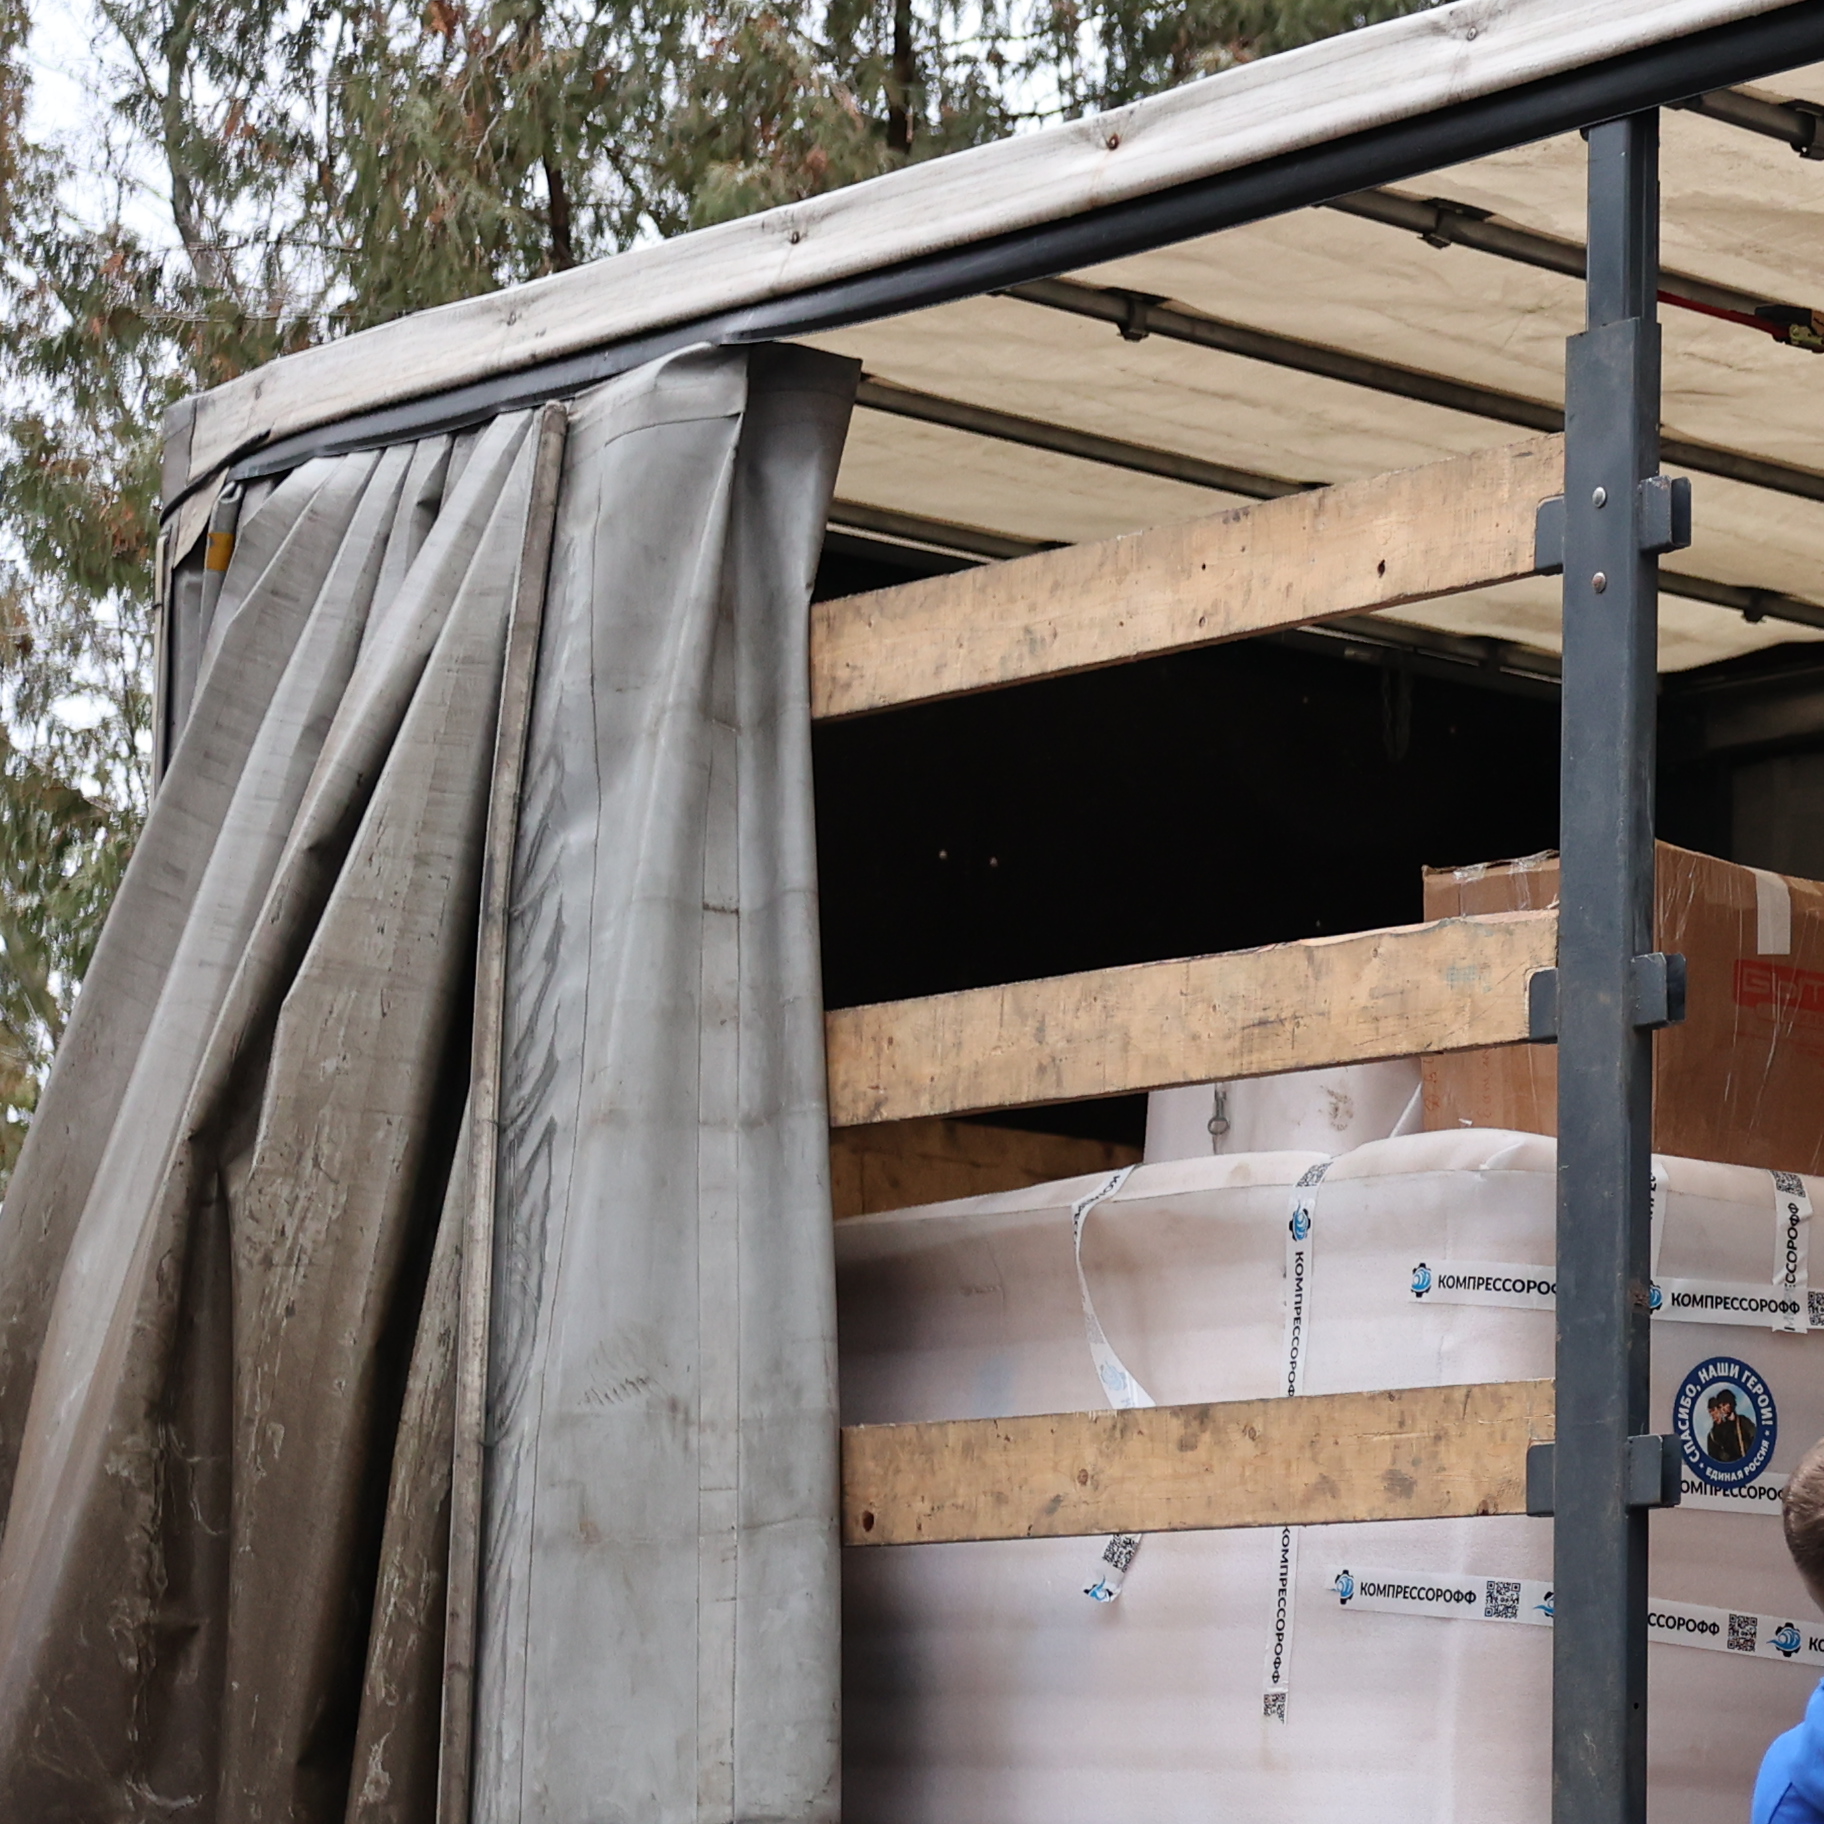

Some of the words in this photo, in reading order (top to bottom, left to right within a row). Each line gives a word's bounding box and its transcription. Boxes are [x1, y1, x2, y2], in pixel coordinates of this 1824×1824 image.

[1671, 1292, 1800, 1315] КОМПРЕССОРОФФ
[1698, 1362, 1740, 1384] НАШИ
[1705, 1466, 1744, 1482] ЕДИНАЯ
[1744, 1440, 1770, 1477] РОССИЯ
[1360, 1581, 1477, 1605] КОМПРЕССОРОФФ
